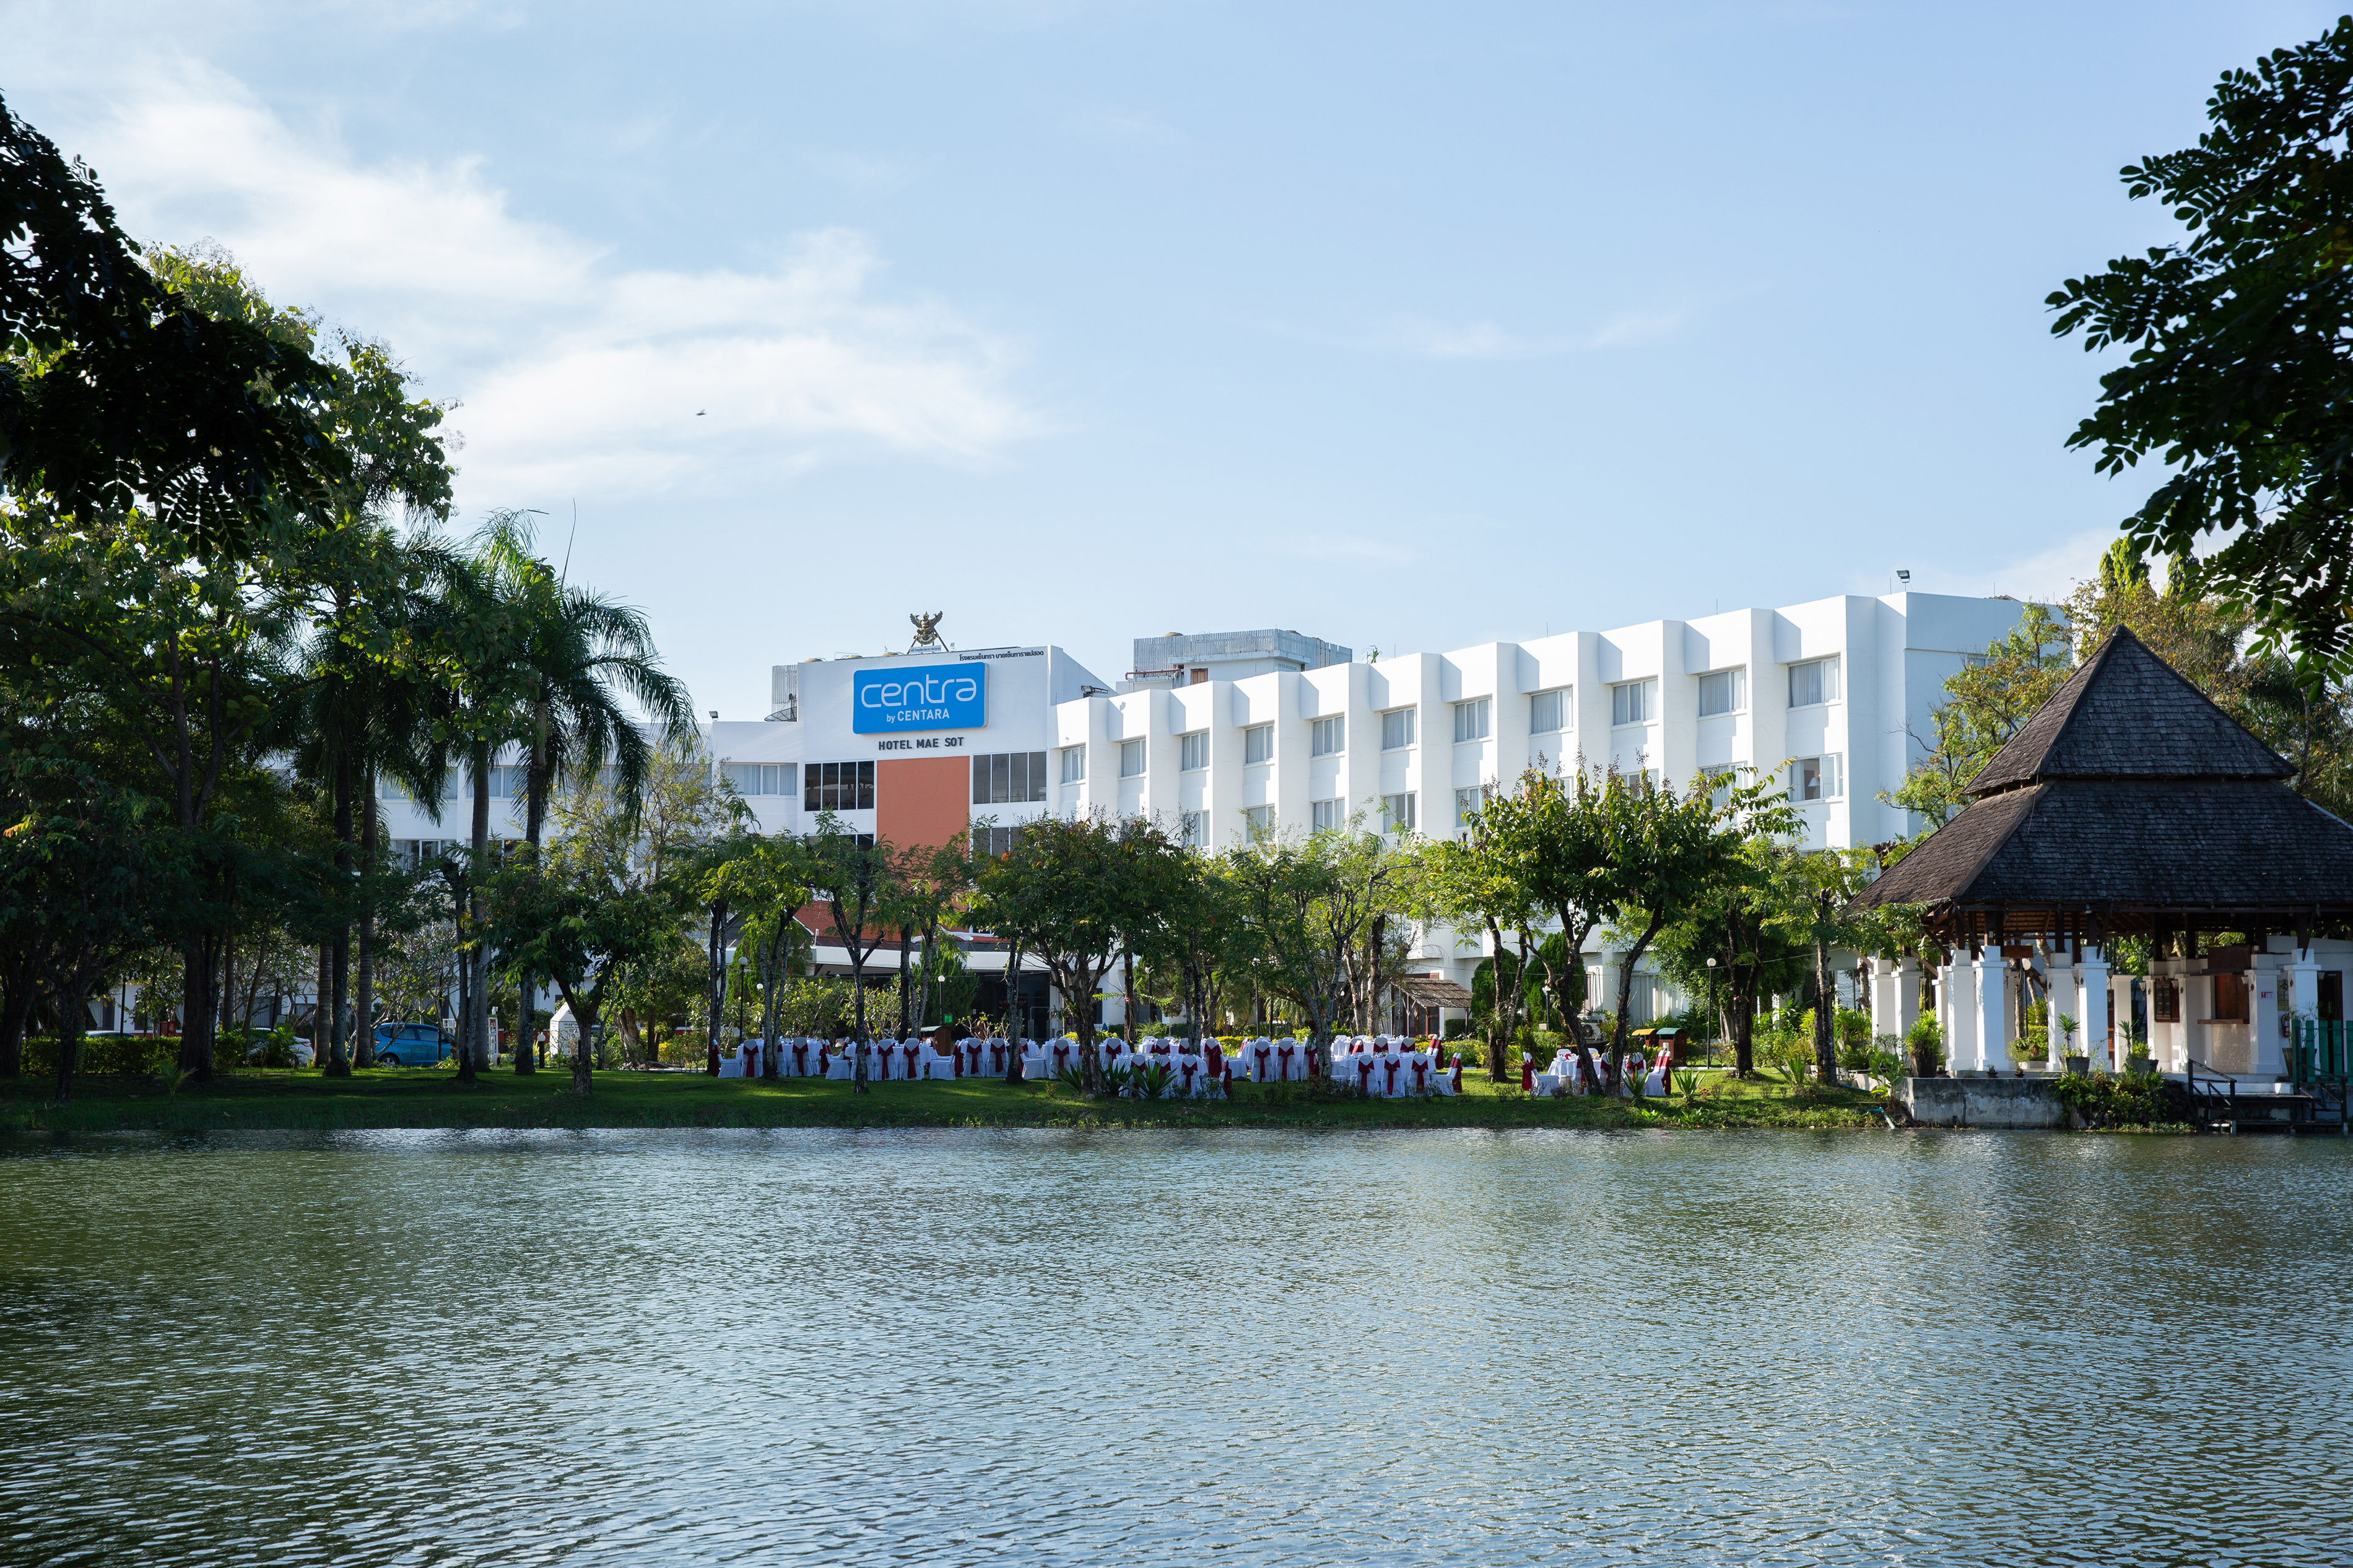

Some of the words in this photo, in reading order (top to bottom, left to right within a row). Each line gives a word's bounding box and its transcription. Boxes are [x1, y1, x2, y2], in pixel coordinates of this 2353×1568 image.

[861, 674, 976, 708] centra
[887, 714, 895, 723] by
[897, 709, 949, 721] CENTARA
[879, 740, 912, 750] HOTEL
[916, 739, 939, 748] MAE
[944, 737, 963, 747] SOT
